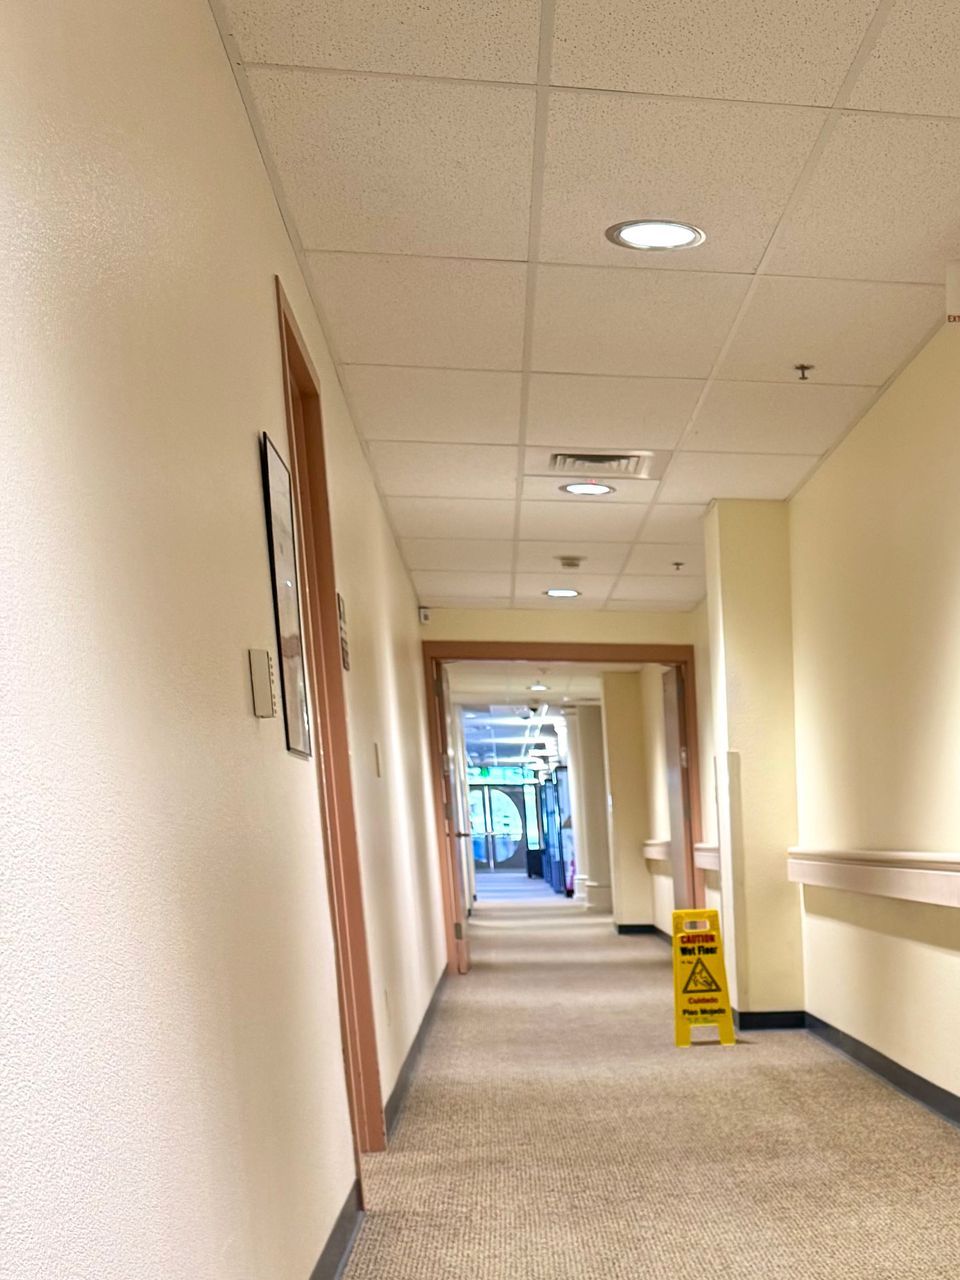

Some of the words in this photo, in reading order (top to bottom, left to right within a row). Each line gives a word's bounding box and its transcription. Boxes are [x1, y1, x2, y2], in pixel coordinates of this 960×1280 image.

[681, 934, 716, 944] CAUTION
[680, 946, 696, 955] Wet
[698, 945, 717, 955] Floor
